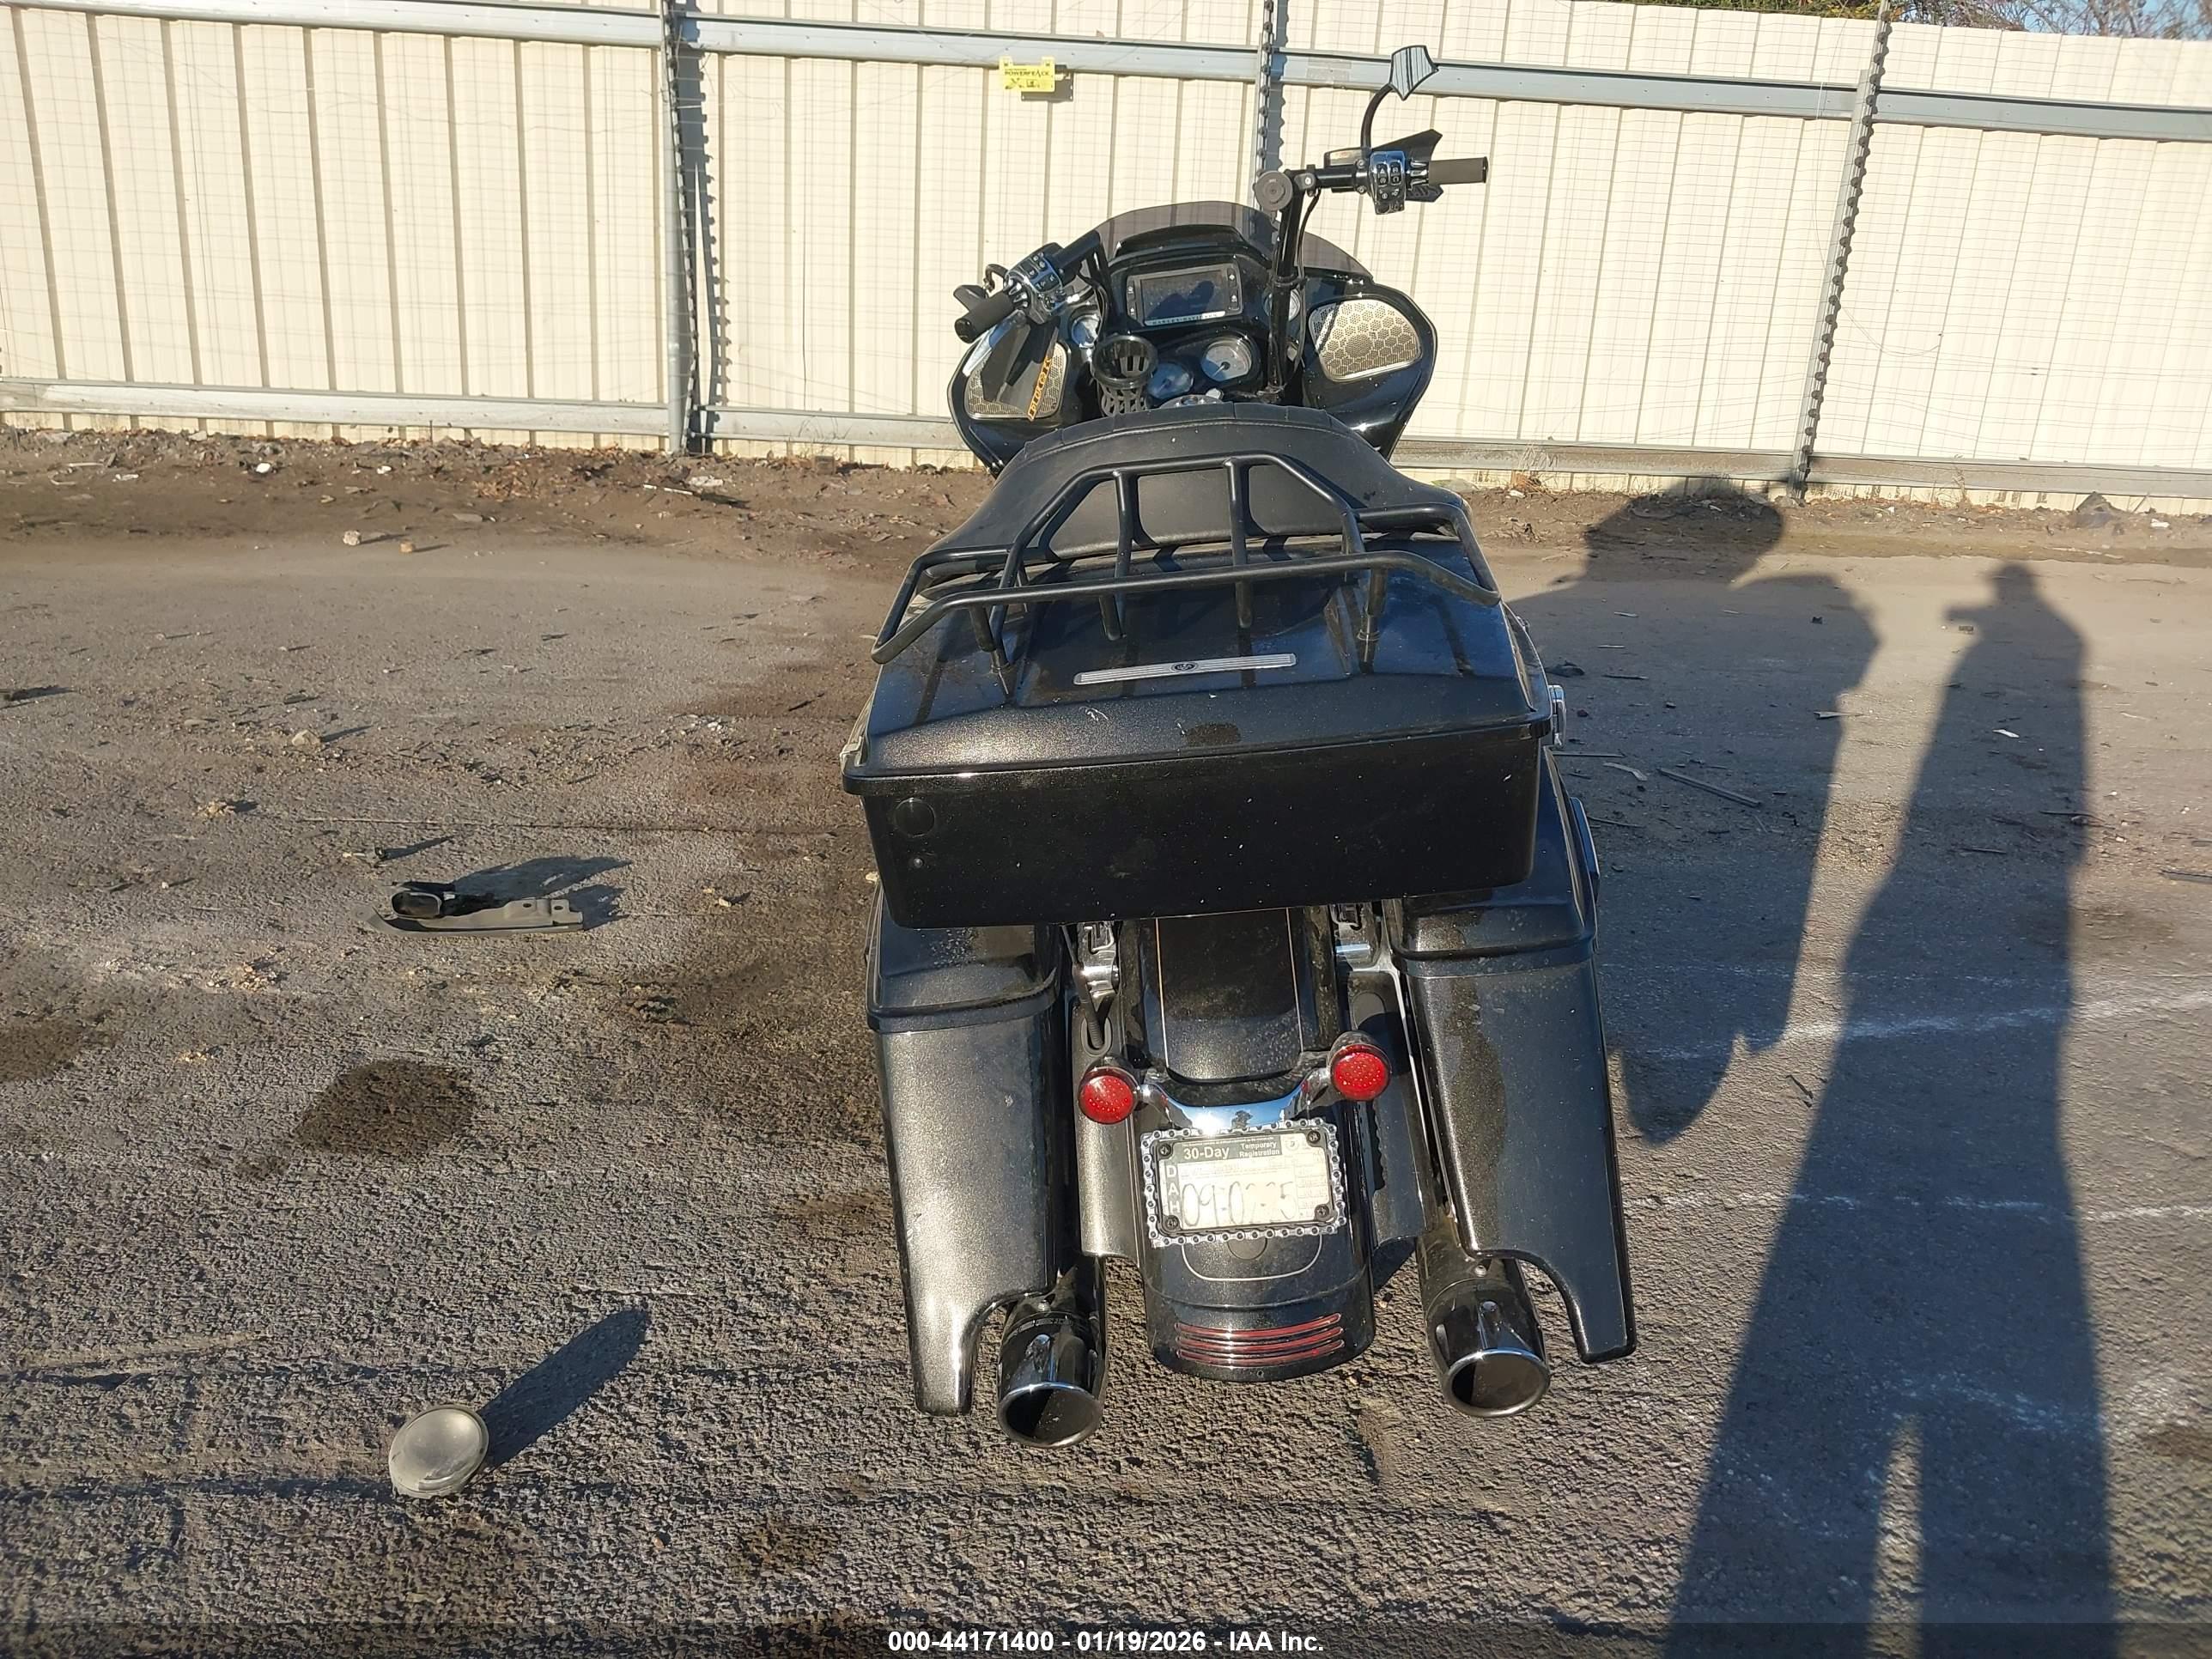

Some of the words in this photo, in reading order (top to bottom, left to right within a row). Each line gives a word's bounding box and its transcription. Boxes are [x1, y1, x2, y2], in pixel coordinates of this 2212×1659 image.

[1241, 1140, 1277, 1151] Temporary
[1184, 1146, 1230, 1159] 30-Day
[1239, 1149, 1280, 1158] Registration
